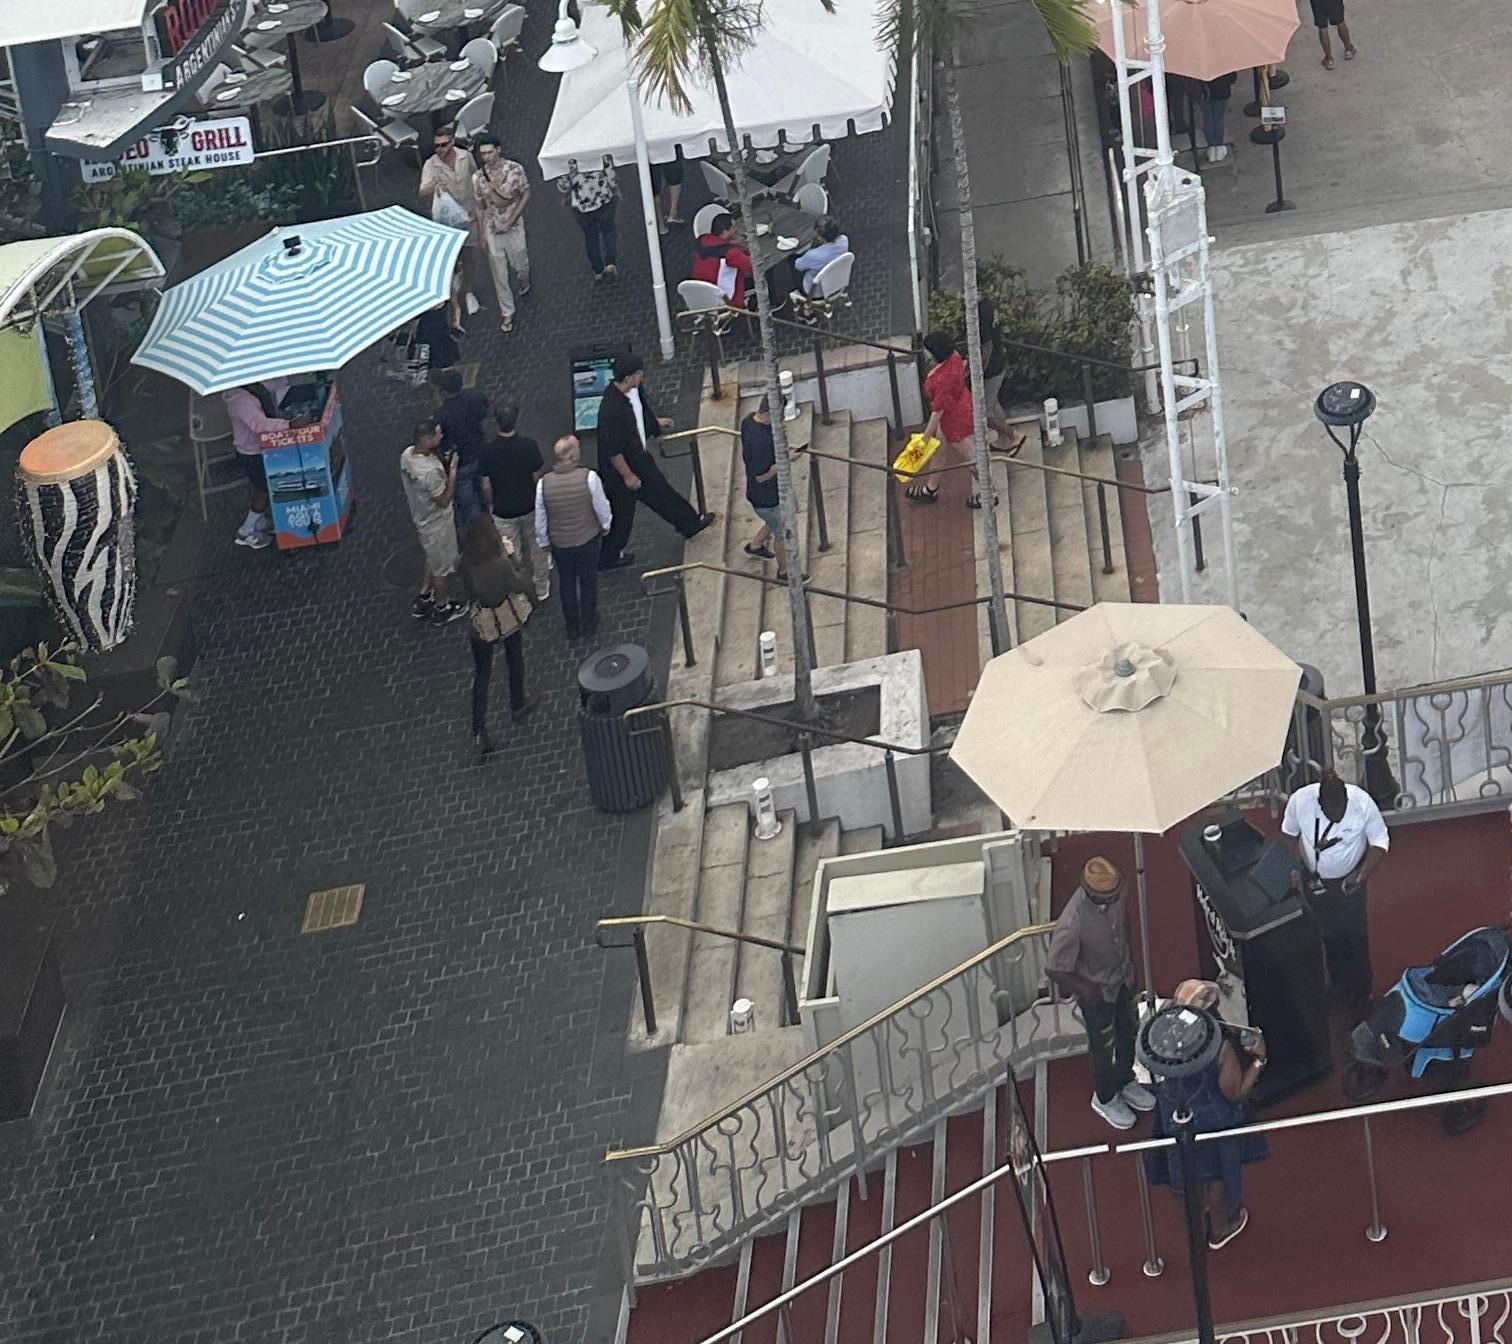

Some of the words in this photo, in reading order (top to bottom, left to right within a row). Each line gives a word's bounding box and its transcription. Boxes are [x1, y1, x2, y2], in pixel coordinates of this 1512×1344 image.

[191, 126, 247, 152] GRILL
[168, 156, 200, 170] STEAK
[205, 150, 241, 163] HOUSE
